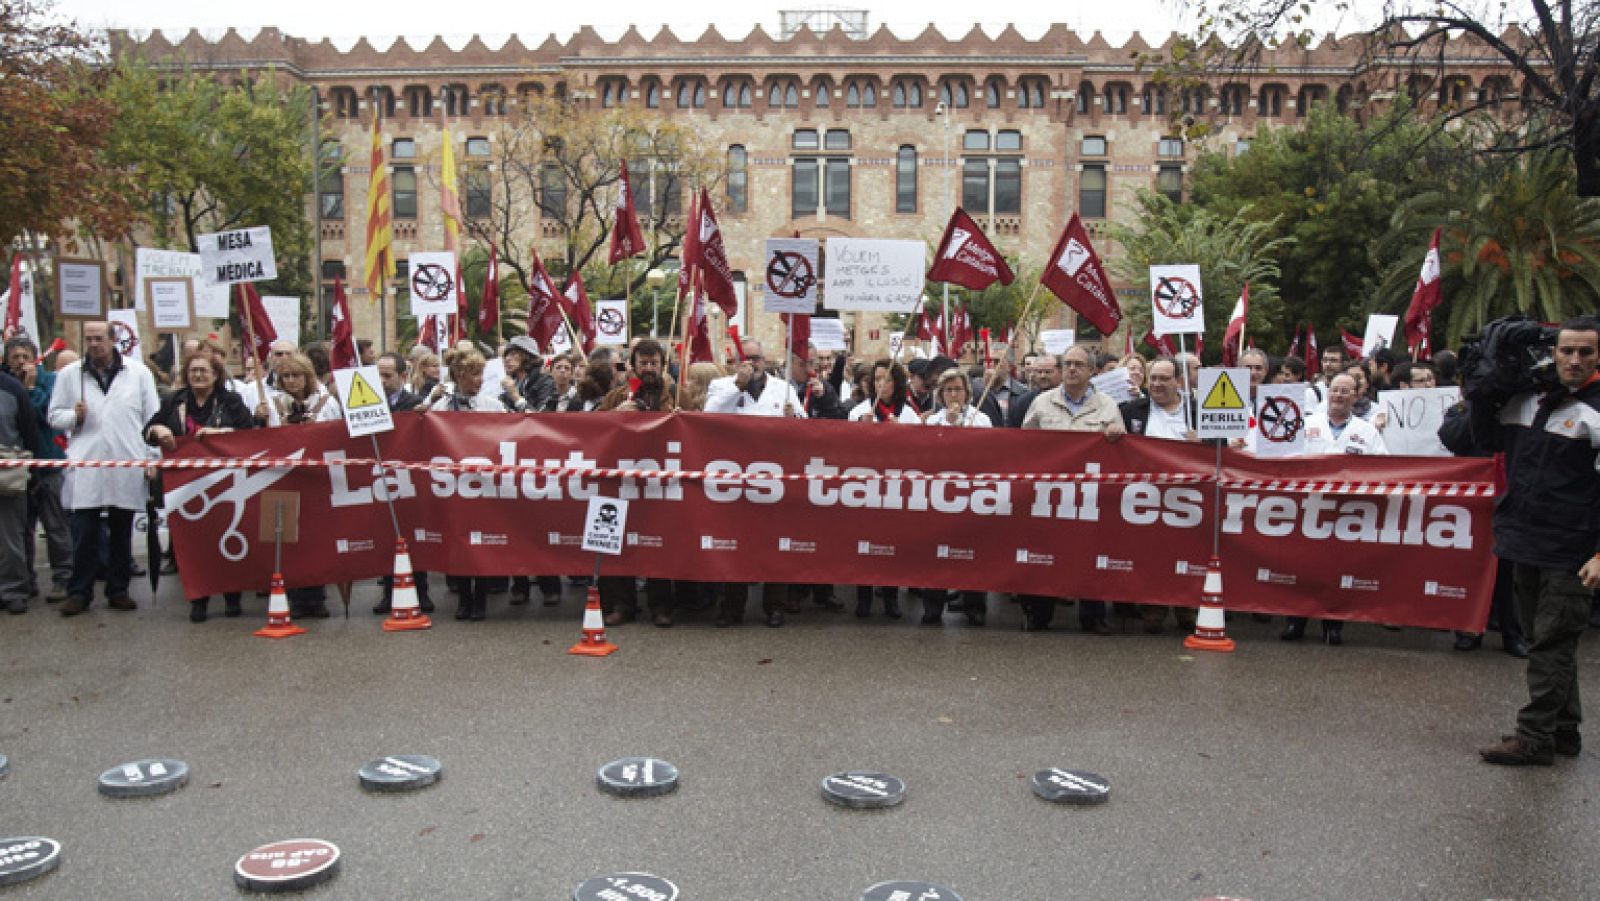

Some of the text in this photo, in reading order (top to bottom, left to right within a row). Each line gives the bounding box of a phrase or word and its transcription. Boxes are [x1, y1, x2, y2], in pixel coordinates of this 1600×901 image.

[217, 231, 252, 251] MESA
[834, 244, 880, 263] VOLEM
[350, 408, 387, 421] PERILL
[1202, 412, 1245, 423] PERILL
[1386, 396, 1425, 430] NO
[323, 441, 1474, 550] La salut ni es tanca ni es retalla
